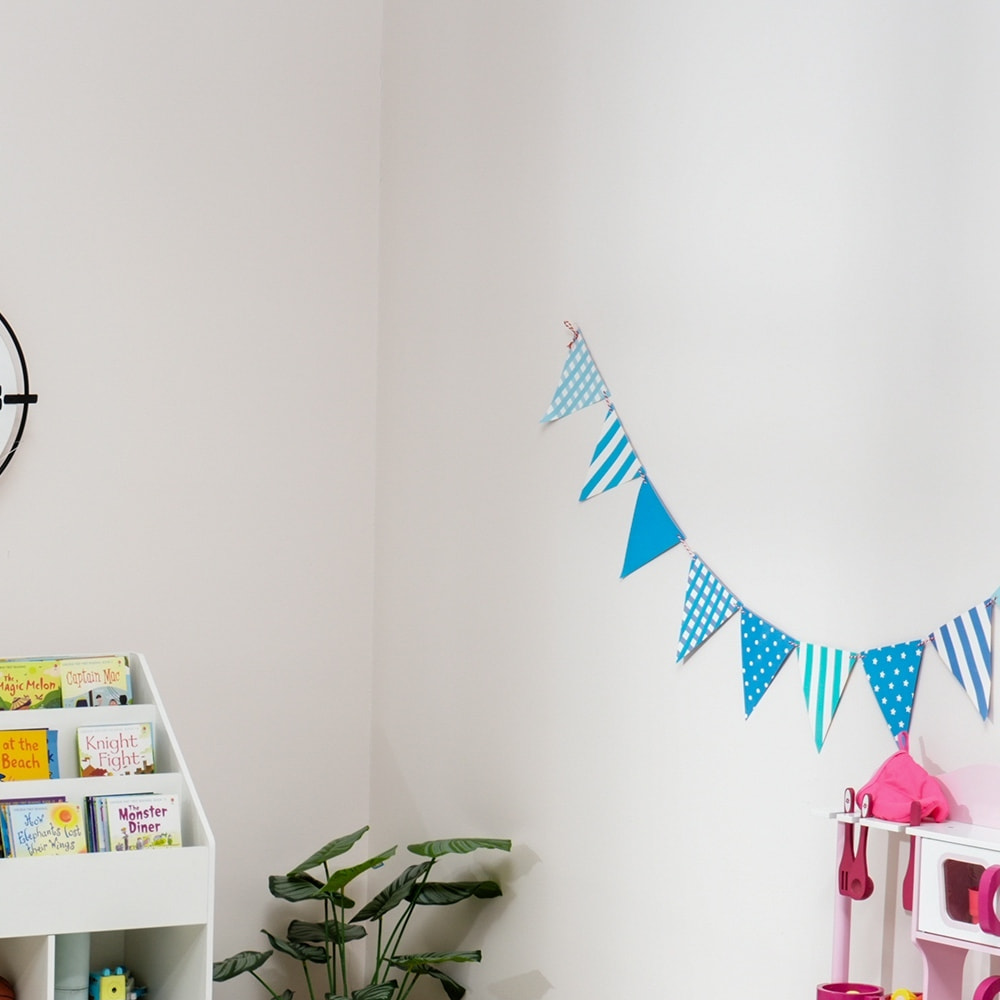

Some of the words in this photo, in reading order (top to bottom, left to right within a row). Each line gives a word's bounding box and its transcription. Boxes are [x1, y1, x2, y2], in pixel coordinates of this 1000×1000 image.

[4, 673, 14, 681] The
[26, 677, 56, 690] Melon
[66, 669, 101, 688] Captain
[103, 668, 120, 684] Mac
[2, 737, 16, 750] at
[18, 737, 39, 751] the
[85, 732, 138, 754] Knight
[1, 753, 41, 769] Beach
[99, 750, 140, 772] Fight
[24, 811, 44, 827] How
[118, 804, 168, 821] Monster
[17, 822, 61, 845] Elephants
[128, 820, 161, 833] Diner
[25, 842, 48, 856] their
[49, 836, 75, 852] Wings
